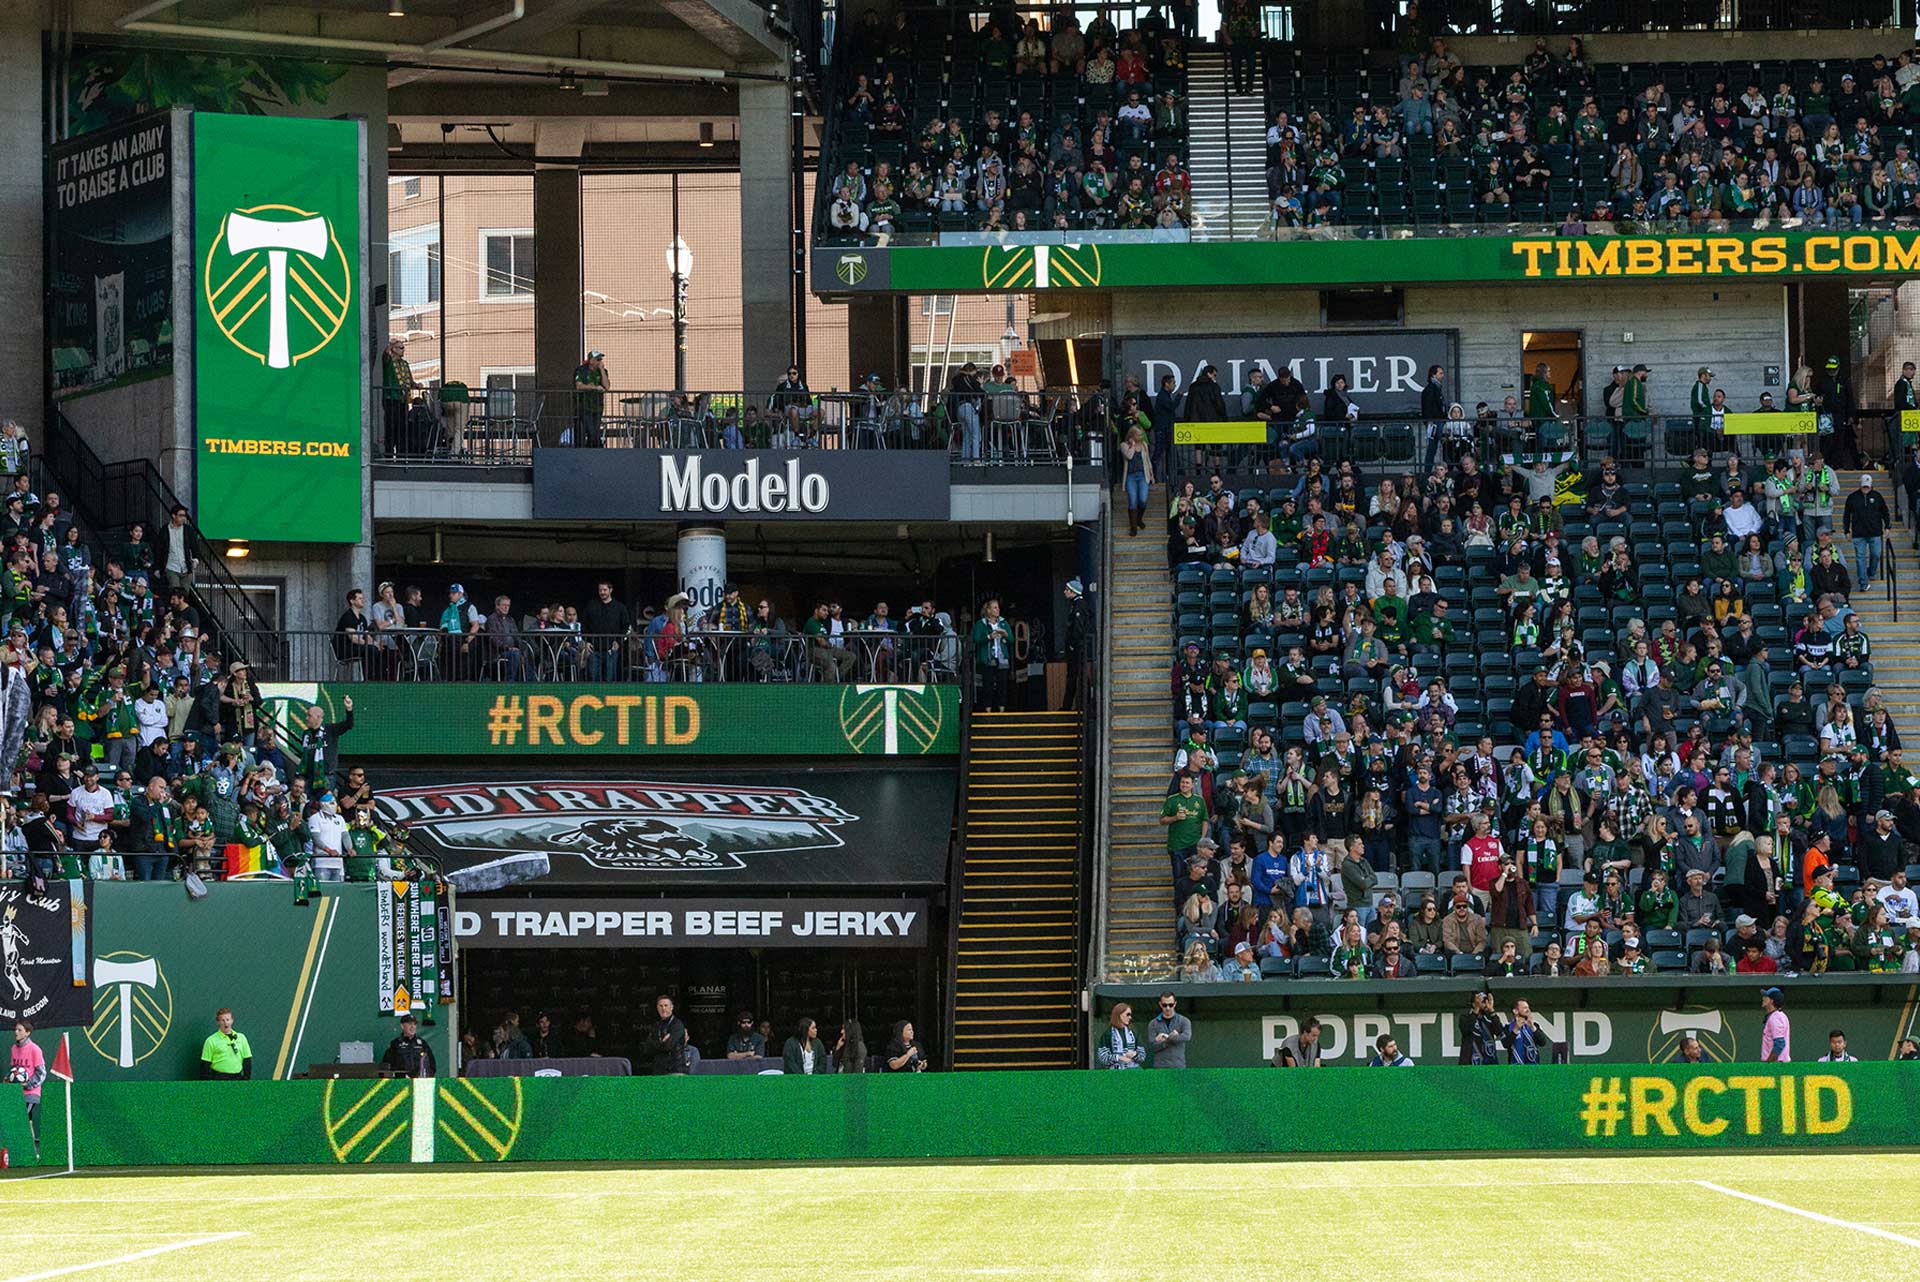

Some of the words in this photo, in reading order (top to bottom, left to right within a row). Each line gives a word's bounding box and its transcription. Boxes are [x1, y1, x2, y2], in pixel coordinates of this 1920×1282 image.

[57, 157, 69, 181] IT
[71, 144, 108, 177] TAKES
[110, 137, 128, 164] AN
[130, 125, 164, 158] ARMY
[57, 182, 76, 209] TO
[79, 168, 117, 204] RAISE
[120, 165, 129, 191] A
[132, 152, 165, 186] CLUB
[1512, 235, 1920, 277] TIMBERS.COM
[1176, 430, 1192, 442] 99
[1798, 419, 1814, 432] 99
[1903, 418, 1919, 430] 98
[205, 438, 350, 457] TIMBERS.COM
[659, 454, 830, 513] Modelo
[488, 695, 700, 746] #RCTID
[486, 786, 846, 818] TRAPPER
[410, 882, 419, 898] SUN
[411, 900, 420, 932] WHERE
[491, 911, 673, 936] TRAPPER
[685, 911, 783, 936] BEEF
[791, 911, 917, 936] JERKY
[397, 942, 406, 980] WELCOME
[411, 935, 421, 965] THERE
[412, 966, 421, 975] IS
[412, 976, 422, 999] NONE
[688, 985, 726, 993] PLANAR
[23, 995, 49, 1018] OREGON
[1262, 1011, 1613, 1060] PORTLND
[1580, 1074, 1853, 1137] #RCTID
